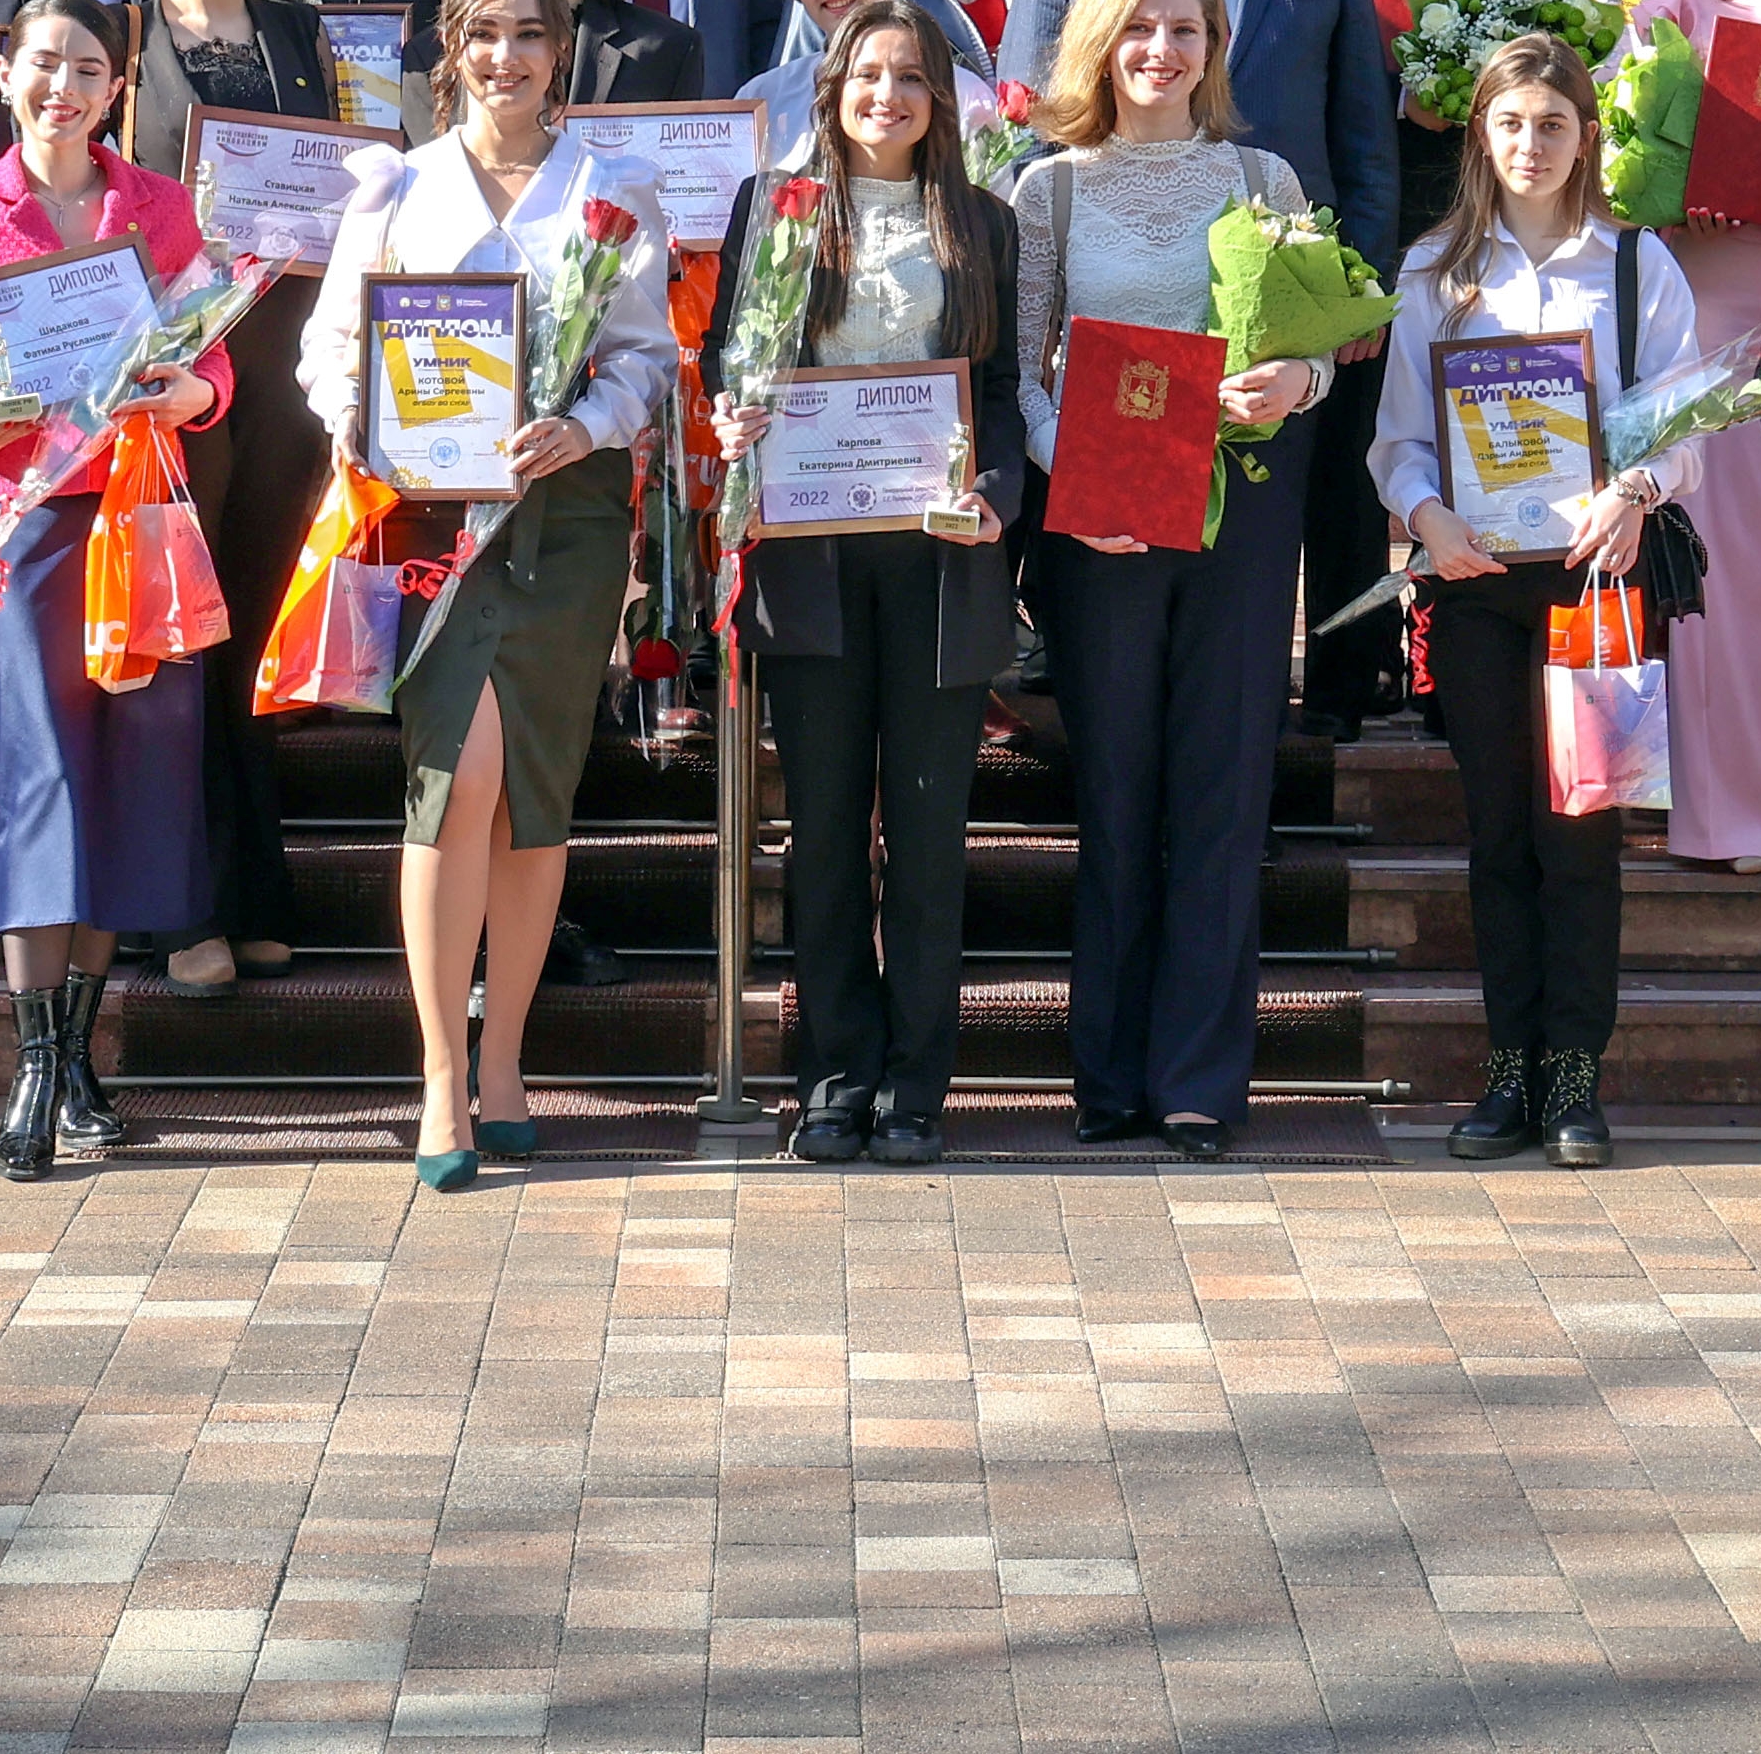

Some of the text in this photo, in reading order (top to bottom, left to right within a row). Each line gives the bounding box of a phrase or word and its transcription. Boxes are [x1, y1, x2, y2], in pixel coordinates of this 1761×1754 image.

[660, 122, 731, 143] ДИПЛОМ
[291, 139, 349, 161] ДИПЛО
[264, 179, 315, 194] Ставицкая
[229, 195, 268, 207] Наталья
[48, 260, 119, 298] ДИПЛОМ
[38, 317, 90, 337] Шидакова
[384, 319, 501, 340] ДИПЛОМ
[23, 342, 61, 360] Фатима
[412, 358, 472, 368] УМНИК
[418, 375, 466, 385] КОТОВОЙ
[433, 387, 485, 397] Сергеевны
[856, 384, 932, 410] ДИПЛОМ
[1459, 376, 1574, 407] ДИПЛОМ
[1489, 417, 1547, 432] УМНИК
[837, 437, 882, 449] Карпова
[1488, 435, 1551, 450] БАЛЫКОВОЙ
[799, 456, 922, 471] Екатерина Дмитриевна
[790, 491, 830, 507] 2022
